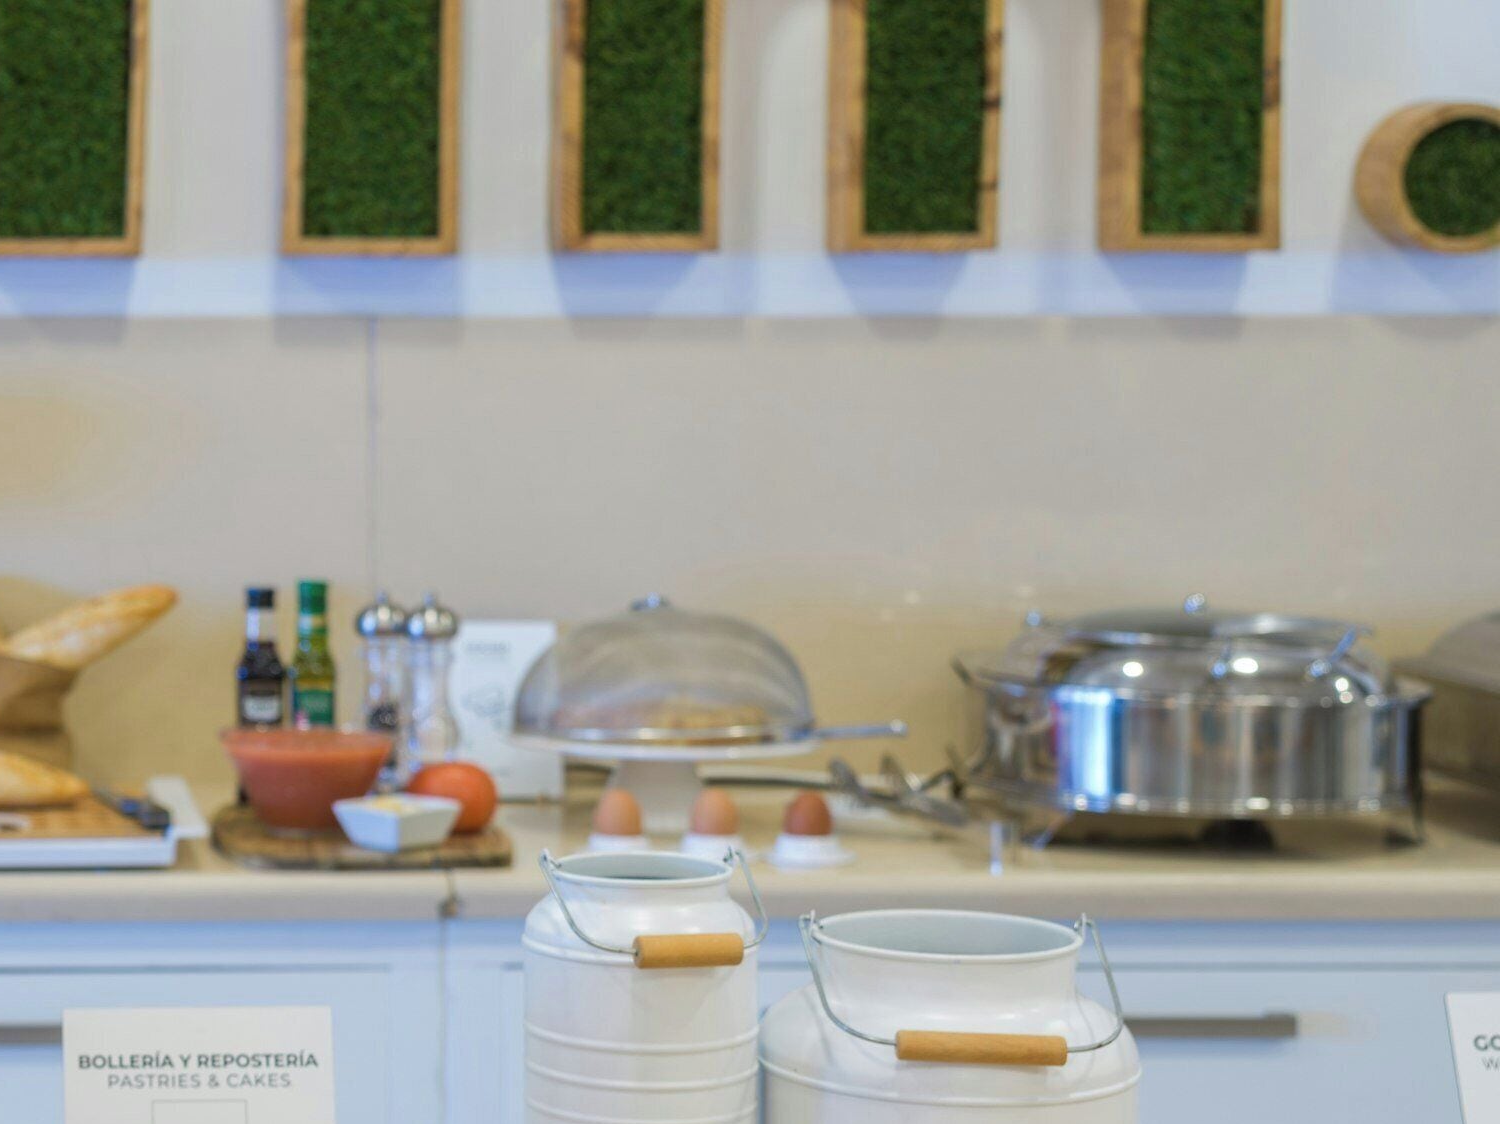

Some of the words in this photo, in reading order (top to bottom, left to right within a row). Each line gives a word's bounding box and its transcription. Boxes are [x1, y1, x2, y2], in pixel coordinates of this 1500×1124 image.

[78, 1050, 174, 1070] BOLLERÍA
[179, 1053, 191, 1068] Y
[197, 1048, 319, 1068] REPOSTERÍA
[107, 1074, 200, 1089] PASTRIES
[207, 1073, 220, 1088] &
[226, 1073, 292, 1088] CAKES
